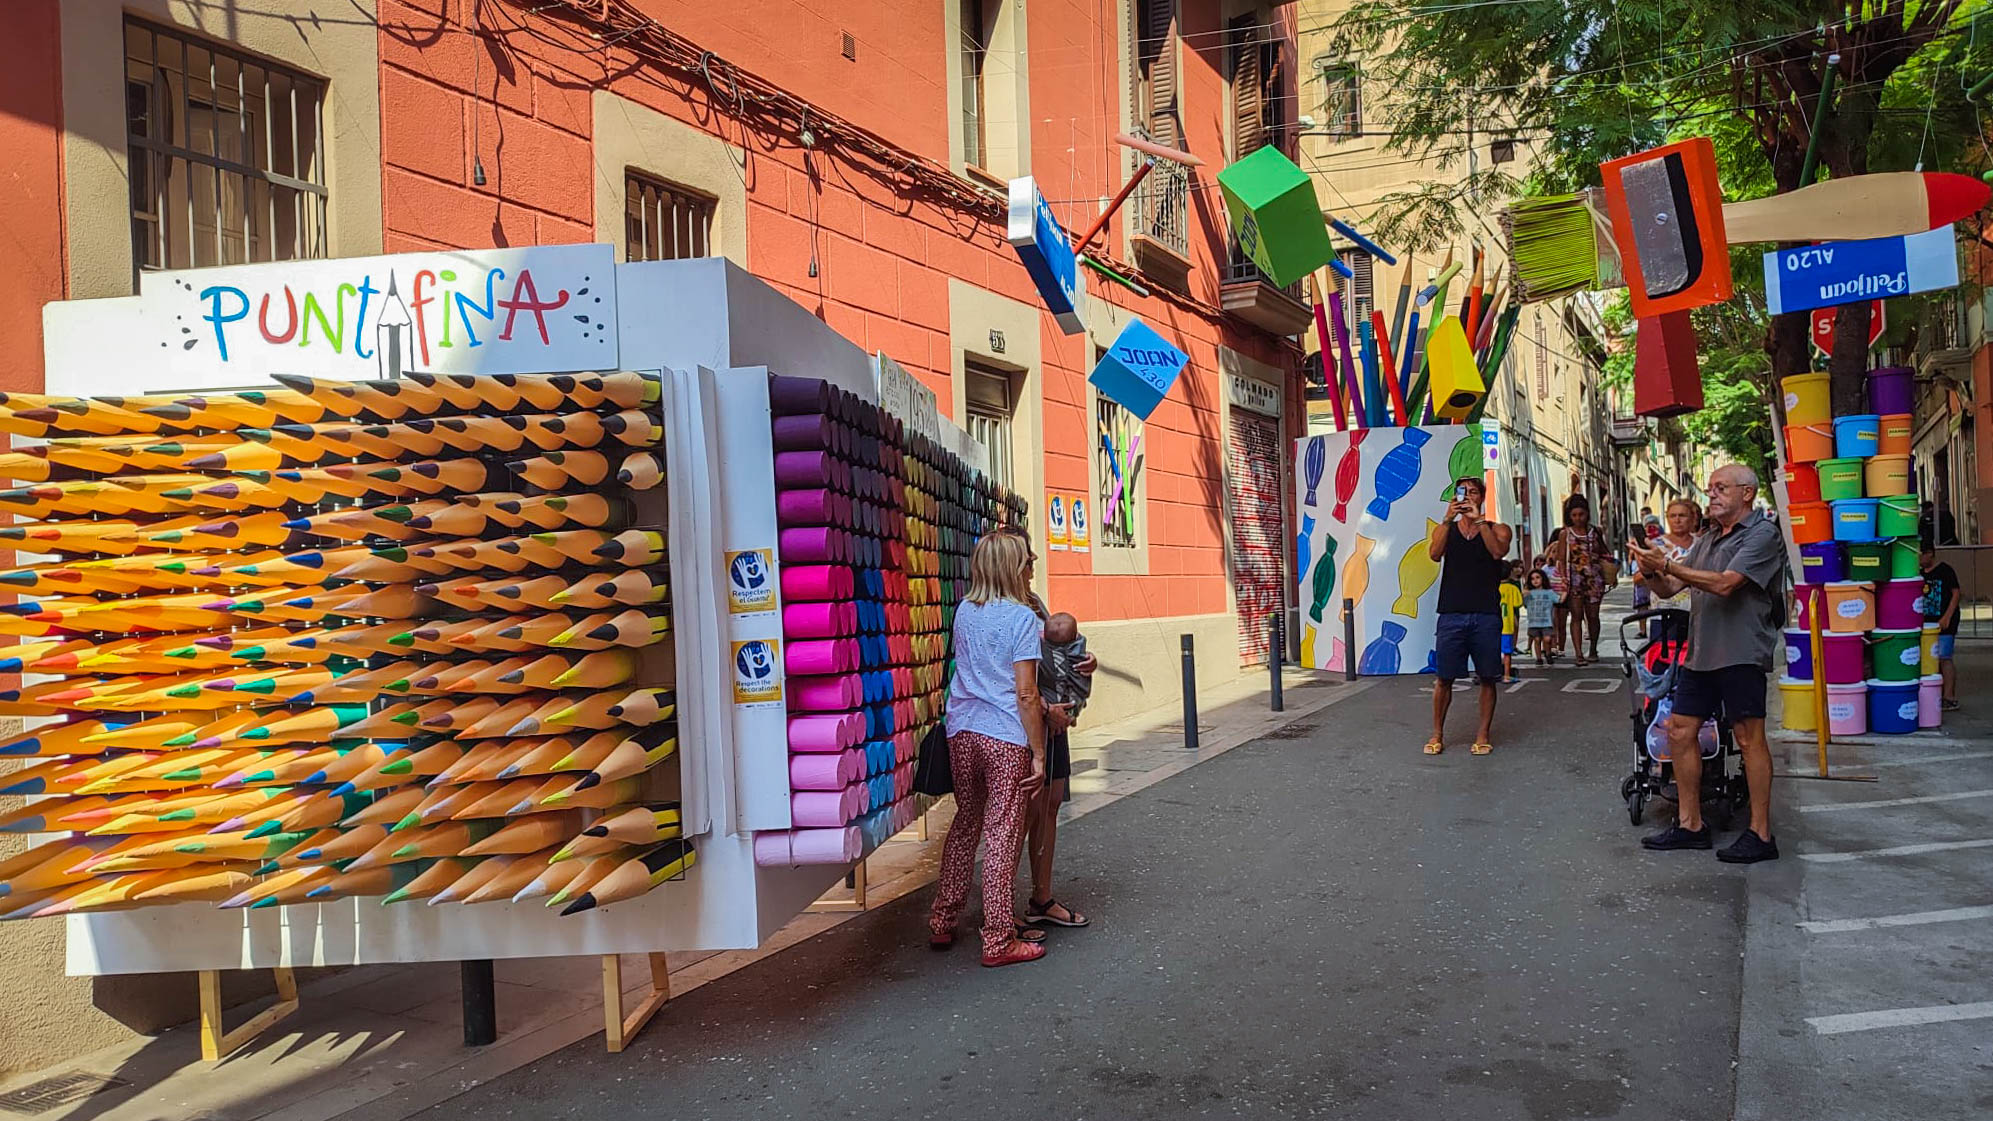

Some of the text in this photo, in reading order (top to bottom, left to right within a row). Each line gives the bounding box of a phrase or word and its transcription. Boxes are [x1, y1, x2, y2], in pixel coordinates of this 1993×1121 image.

[1786, 248, 1834, 272] AL20
[1118, 347, 1180, 368] JOAN
[739, 685, 779, 694] decorations
